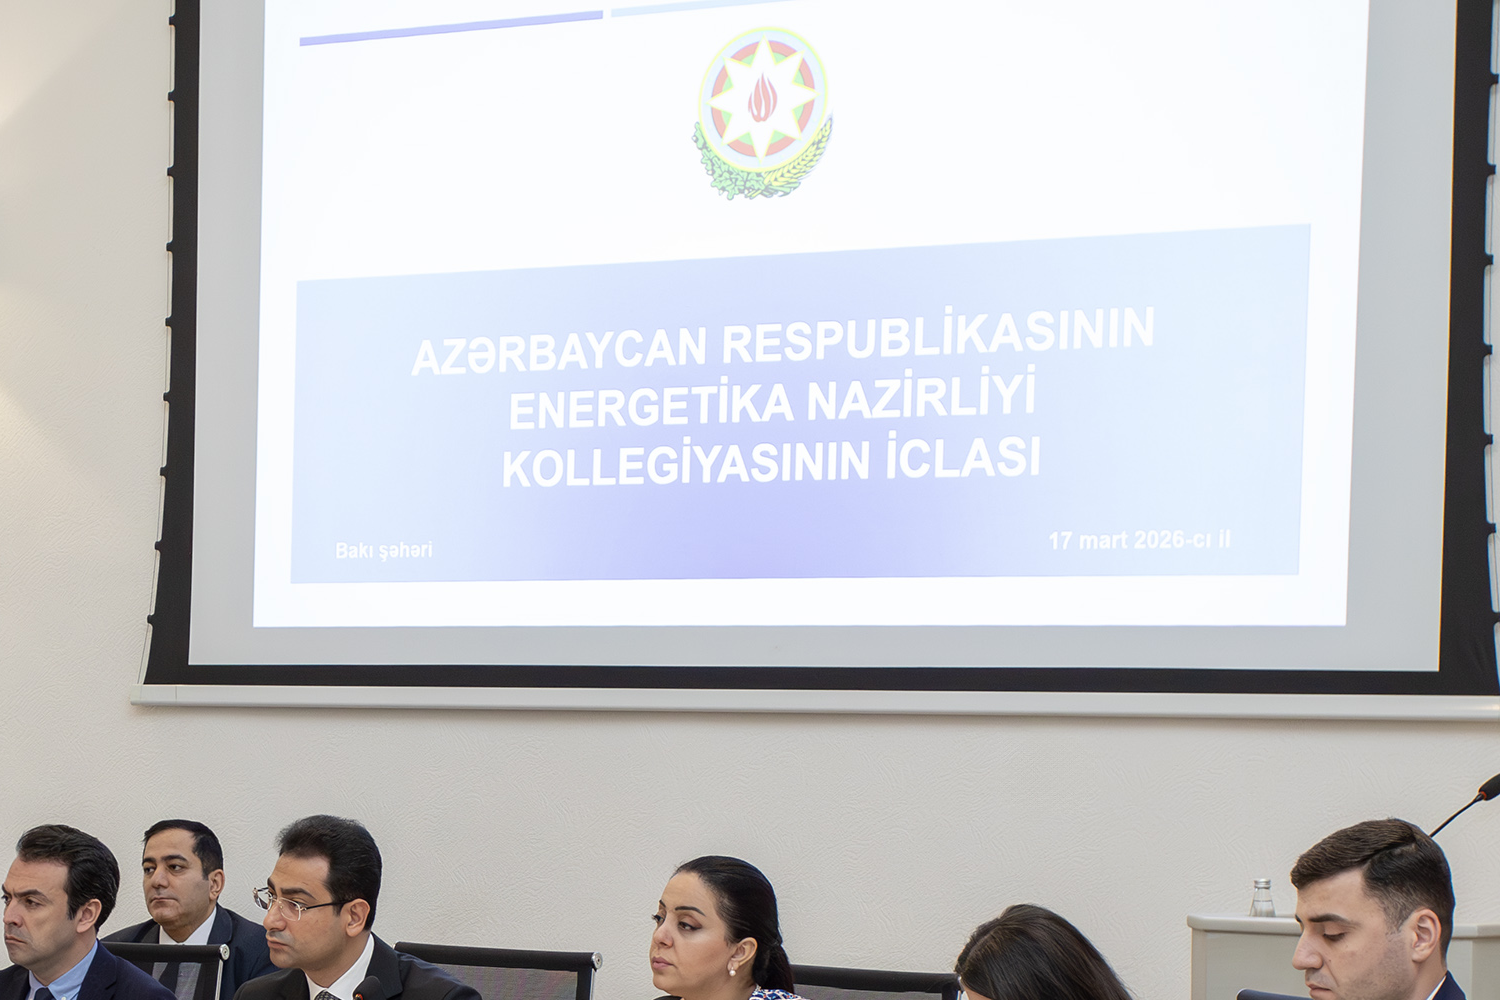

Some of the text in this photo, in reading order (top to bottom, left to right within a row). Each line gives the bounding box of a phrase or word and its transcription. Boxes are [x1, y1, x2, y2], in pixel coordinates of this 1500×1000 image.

[411, 305, 1154, 376] AZƏRBAYCAN RESPUBLİKASININ
[510, 364, 1035, 430] ENERGETİKA NAZİRLİYİ
[503, 430, 1040, 488] KOLLEGİYASININ İCLASI
[336, 540, 433, 562] Bakı şəhəri
[1049, 528, 1231, 550] 17 mart 2026-cı il
